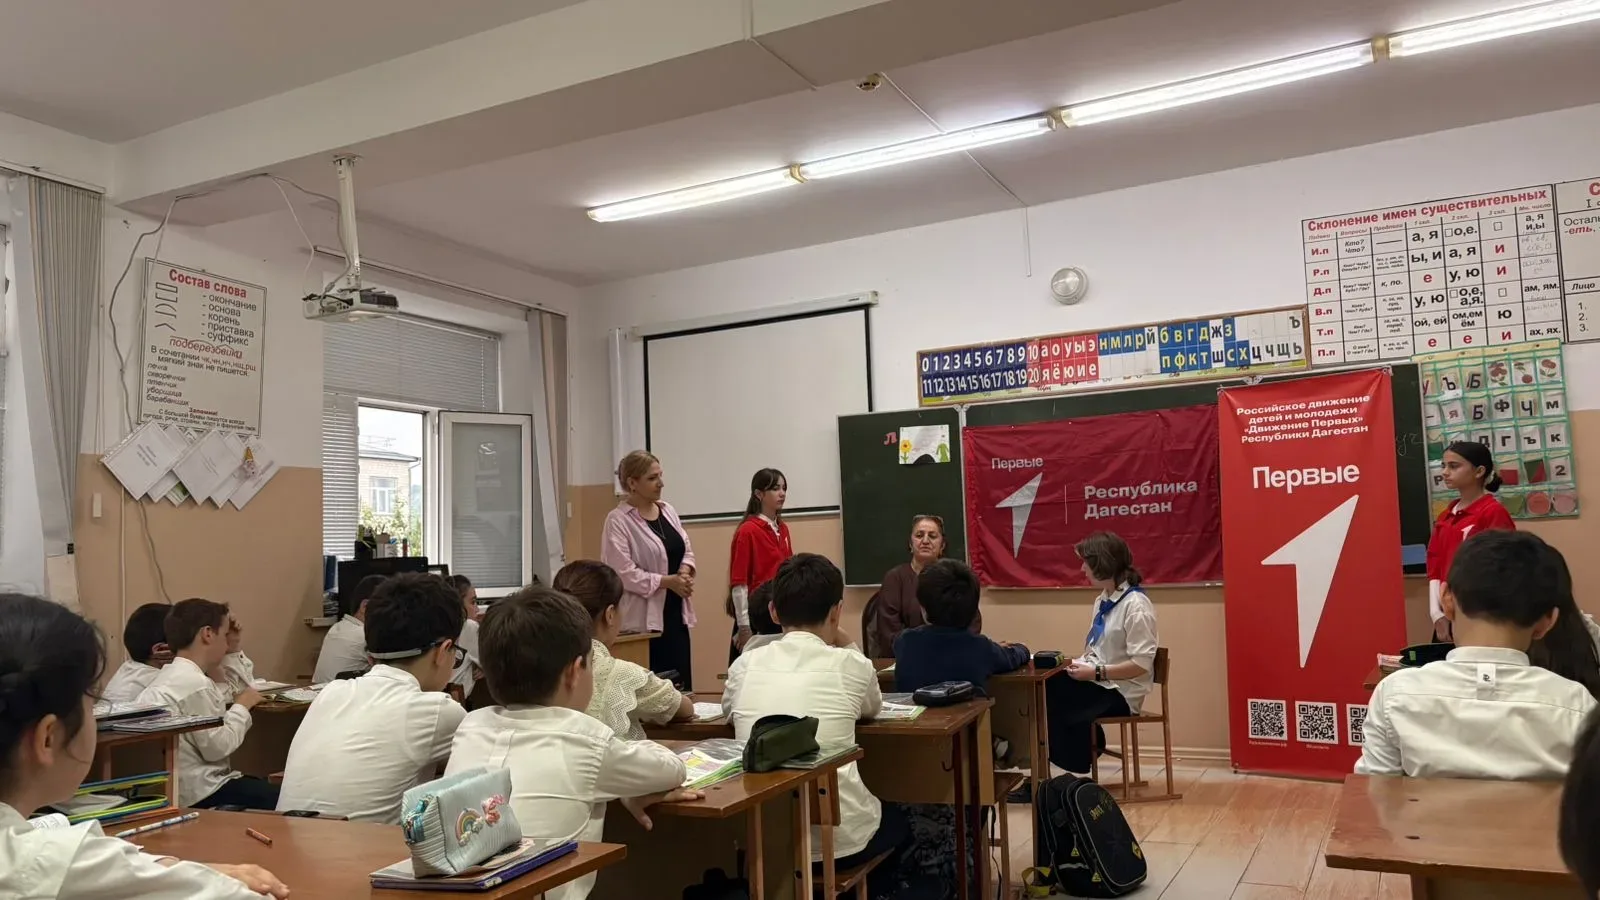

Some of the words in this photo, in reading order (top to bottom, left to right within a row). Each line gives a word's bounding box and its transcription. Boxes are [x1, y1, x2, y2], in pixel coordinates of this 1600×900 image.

[1308, 214, 1379, 232] Склонение
[1383, 208, 1416, 221] имен
[1421, 190, 1547, 217] существительных
[1429, 230, 1438, 240] я
[1345, 246, 1365, 254] Что?
[1432, 251, 1442, 260] и
[1467, 246, 1476, 256] я
[1495, 244, 1504, 254] и
[1466, 268, 1480, 278] ю
[1496, 266, 1506, 275] и
[169, 268, 210, 289] Состав
[214, 282, 247, 298] слова
[1424, 274, 1432, 283] е
[1572, 282, 1596, 290] Лицо
[208, 294, 257, 312] окончание
[1431, 294, 1444, 304] ю
[208, 304, 241, 317] основа
[1498, 310, 1512, 319] ю
[208, 313, 240, 326] корень
[1434, 316, 1447, 325] ей
[208, 322, 254, 338] приставка
[1502, 331, 1512, 340] и
[208, 332, 249, 346] суффикс
[1428, 338, 1437, 348] е
[1463, 335, 1472, 344] е
[151, 345, 156, 354] В
[159, 348, 200, 361] сочетании
[922, 358, 929, 372] 0
[934, 357, 938, 370] 1
[943, 356, 950, 370] 2
[954, 354, 960, 369] 3
[964, 353, 971, 367] 4
[974, 352, 981, 366] 5
[985, 350, 992, 366] 6
[996, 350, 1003, 364] 7
[1008, 348, 1014, 363] 8
[1018, 346, 1025, 362] 9
[1028, 344, 1038, 360] 10
[1041, 348, 1048, 358] а
[1074, 341, 1086, 352] ы
[1089, 340, 1096, 350] э
[1100, 338, 1108, 350] н
[1111, 336, 1120, 348] м
[1124, 335, 1132, 348] л
[1136, 333, 1144, 348] р
[1160, 325, 1169, 344] б
[1174, 330, 1182, 342] в
[1188, 328, 1194, 340] г
[1200, 326, 1209, 342] д
[158, 356, 185, 366] мягкий
[187, 361, 204, 370] знак
[924, 379, 932, 394] 11
[934, 378, 944, 393] 12
[944, 377, 955, 392] 13
[956, 376, 966, 390] 14
[967, 375, 978, 390] 15
[979, 374, 990, 388] 16
[991, 372, 1001, 388] 17
[1003, 370, 1014, 386] 18
[1016, 369, 1026, 384] 19
[1028, 368, 1038, 382] 20
[1042, 369, 1050, 380] я
[1053, 364, 1060, 380] ё
[1064, 366, 1074, 378] ю
[1078, 365, 1086, 376] и
[1089, 364, 1096, 376] е
[1162, 355, 1170, 368] п
[1175, 352, 1184, 370] ф
[1236, 402, 1306, 416] Российское
[1308, 395, 1370, 410] движение
[1248, 414, 1282, 424] детей
[1294, 406, 1358, 420] молодежи
[1244, 421, 1309, 434] «Движение
[1312, 417, 1363, 428] Первых»
[1242, 431, 1310, 444] Республики
[1312, 426, 1368, 438] Дагестан
[992, 457, 1044, 472] Первые
[1252, 464, 1360, 494] Первые
[1084, 480, 1198, 500] Республика
[1084, 500, 1172, 520] Дагестан
